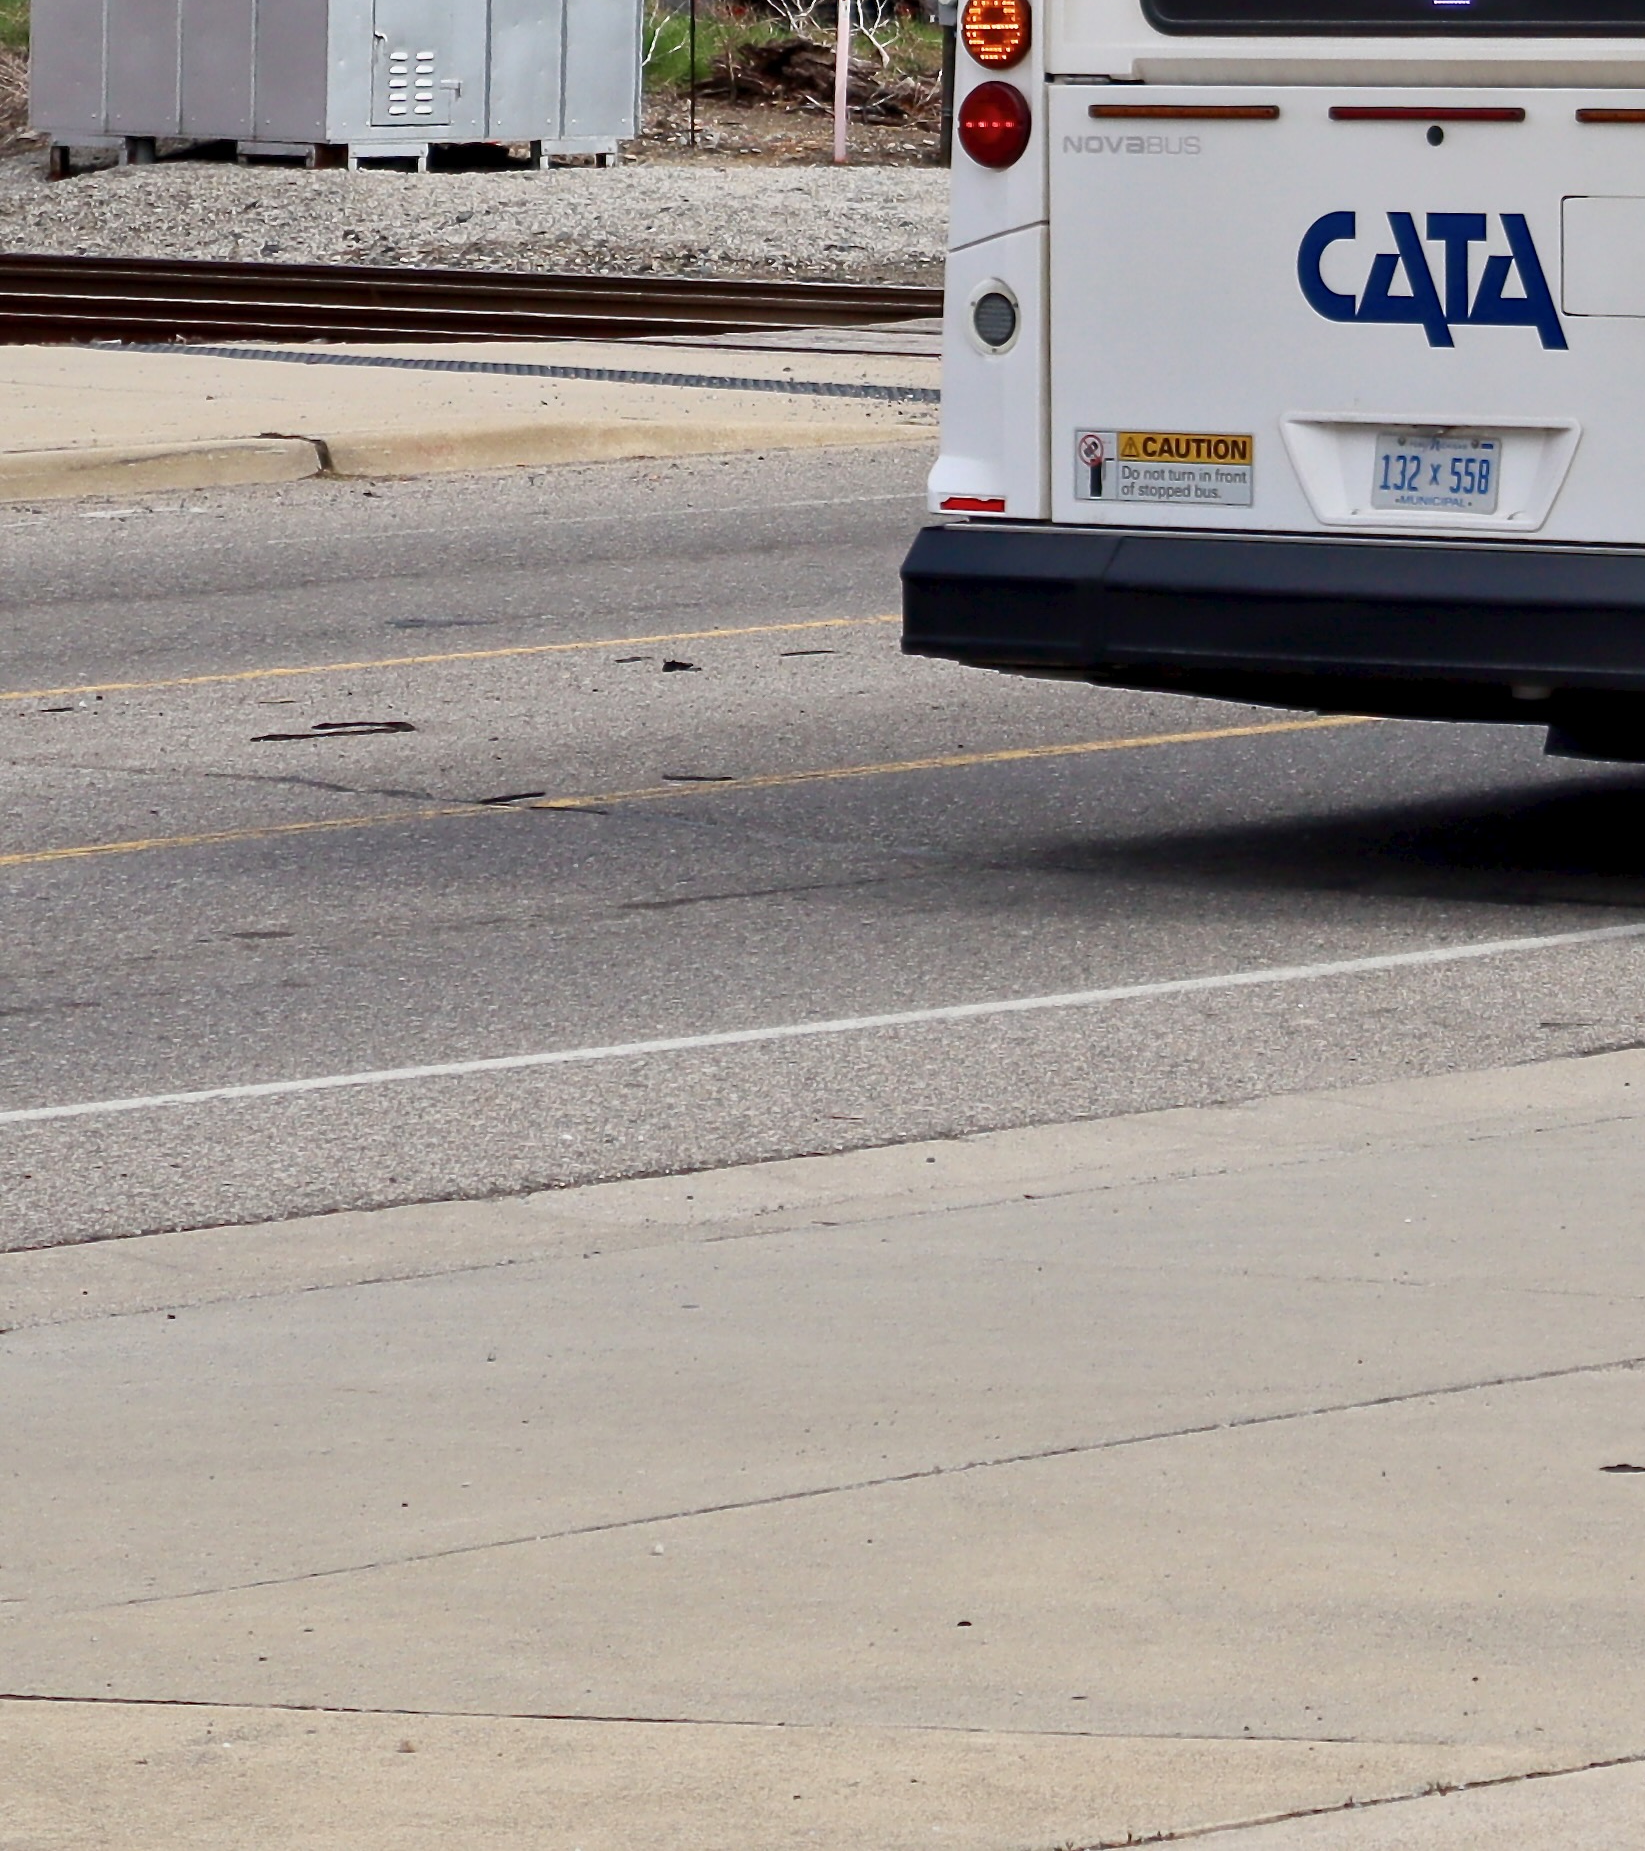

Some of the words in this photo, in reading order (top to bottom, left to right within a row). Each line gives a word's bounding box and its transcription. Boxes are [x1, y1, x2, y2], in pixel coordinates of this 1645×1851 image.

[1297, 210, 1569, 350] CATA
[1142, 436, 1247, 461] CAUTION
[1121, 465, 1140, 481] Do
[1143, 467, 1165, 482] not
[1168, 468, 1196, 483] turn
[1199, 469, 1212, 483] in
[1215, 468, 1247, 484] front
[1379, 454, 1422, 492] 132
[1448, 457, 1490, 494] 558
[1121, 483, 1135, 496] of
[1138, 484, 1191, 499] stopped
[1194, 485, 1222, 499] bus.
